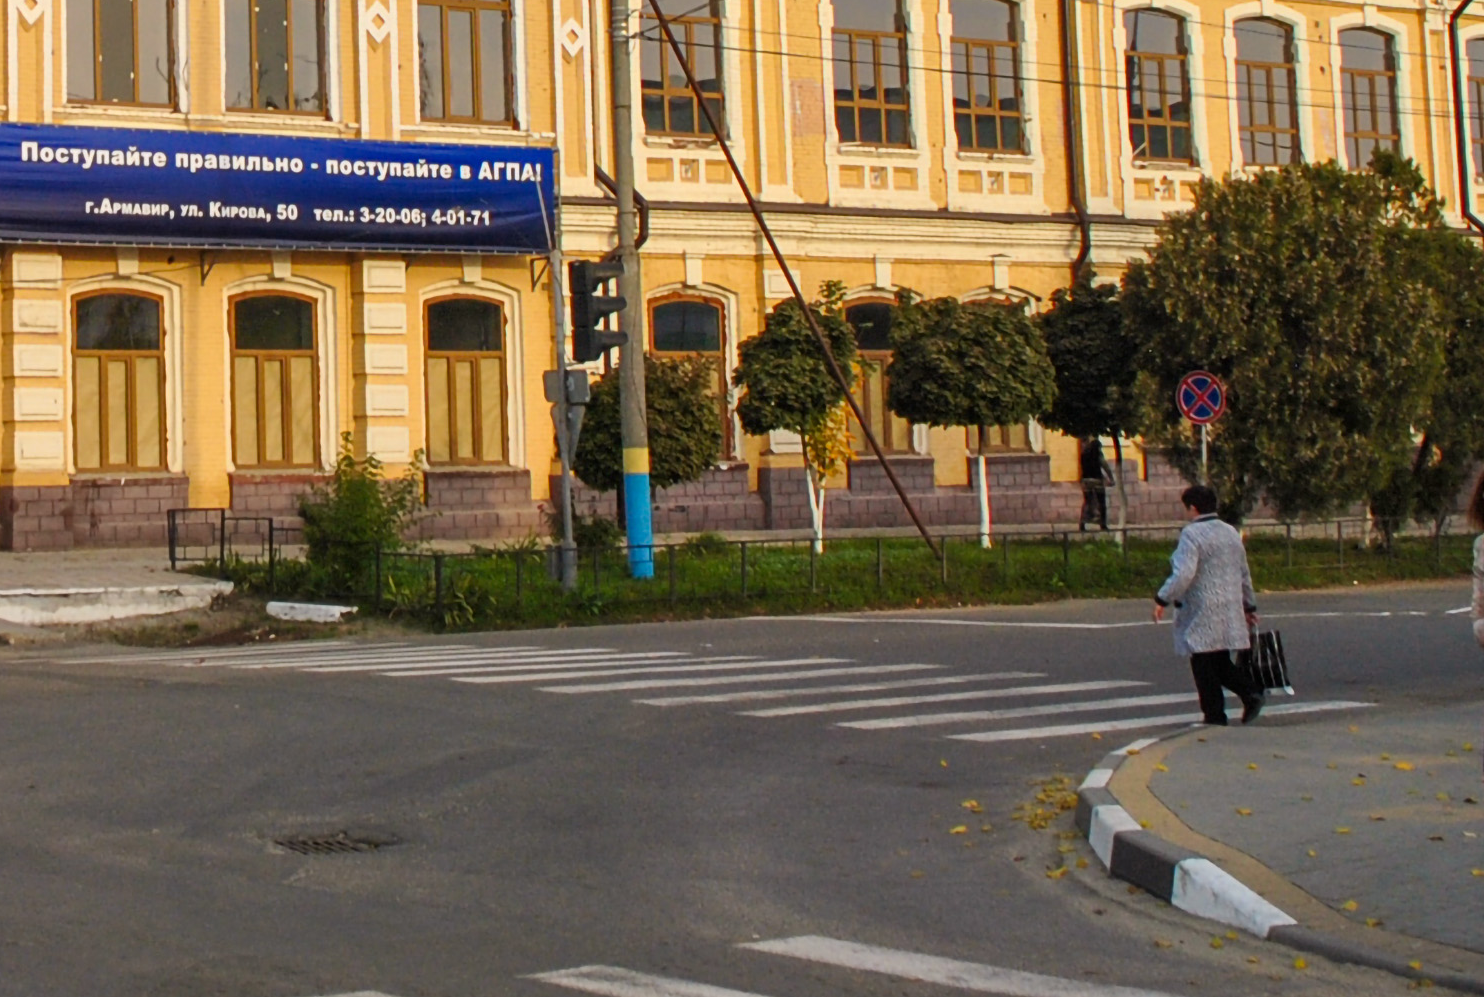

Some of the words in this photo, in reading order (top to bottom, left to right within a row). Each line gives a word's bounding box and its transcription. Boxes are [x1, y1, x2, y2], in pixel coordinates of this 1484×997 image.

[21, 141, 167, 169] Поступайте
[175, 152, 303, 173] правильно
[326, 158, 452, 181] поступайте
[460, 165, 471, 179] в
[478, 161, 542, 182] АГПА!
[180, 204, 203, 217] ул.
[276, 204, 298, 220] 50
[313, 208, 355, 222] тел.:
[360, 207, 427, 227] 3-20-06;
[431, 209, 491, 226] 4-01-71
